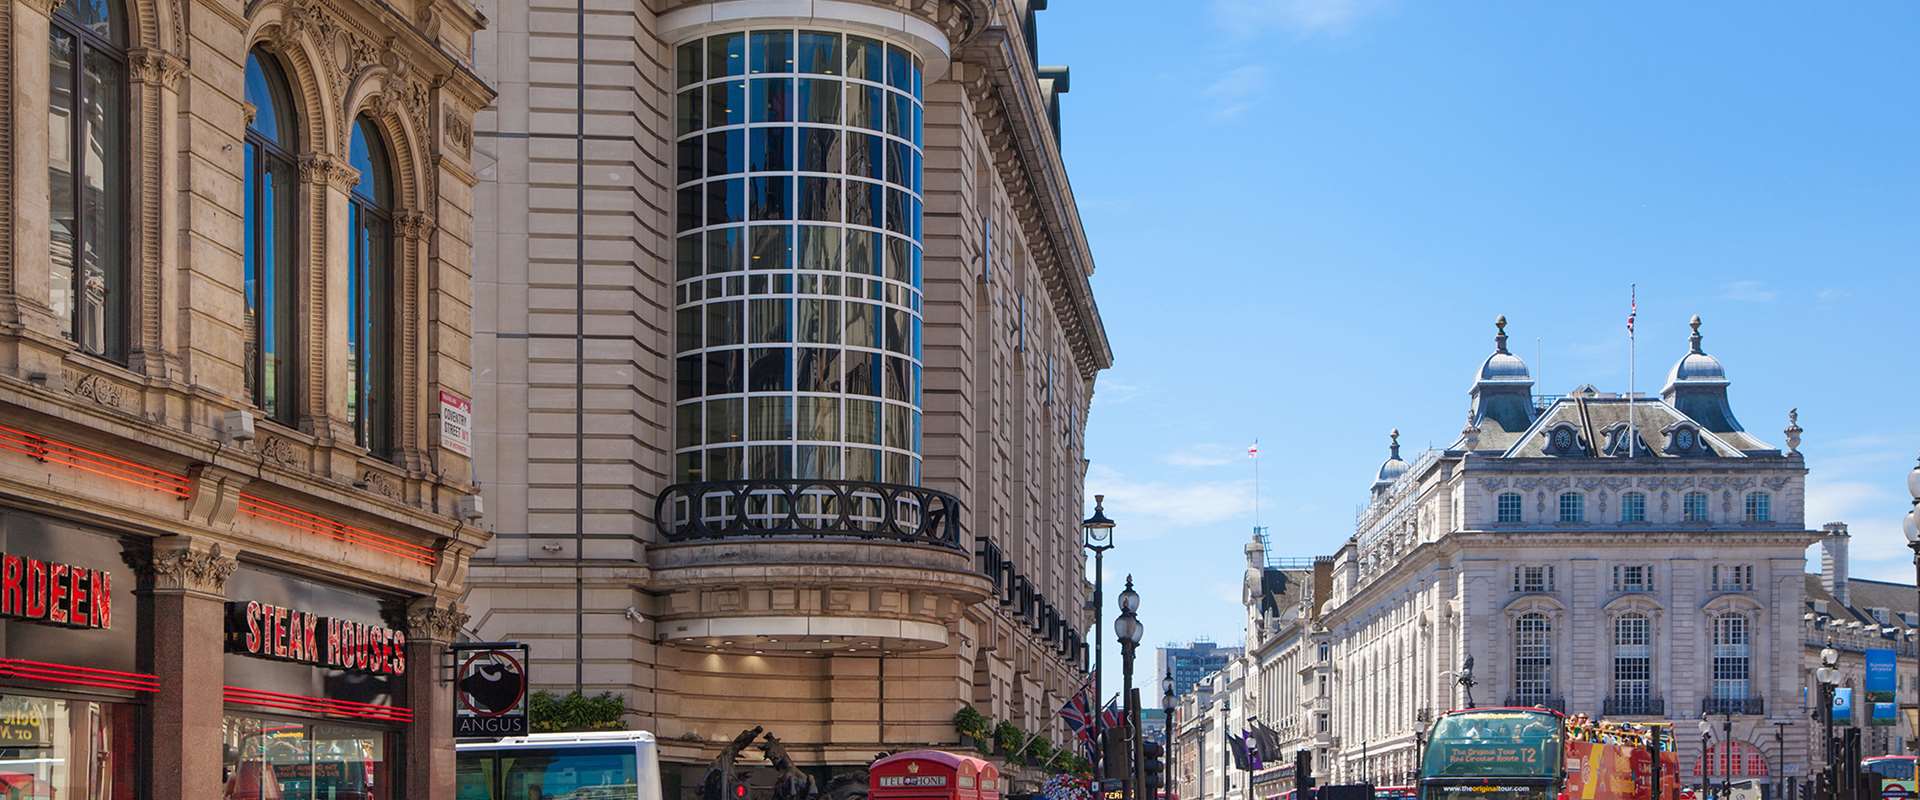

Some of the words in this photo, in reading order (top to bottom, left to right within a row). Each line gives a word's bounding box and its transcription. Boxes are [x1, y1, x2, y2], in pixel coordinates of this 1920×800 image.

[445, 408, 467, 425] COVENTRY
[445, 421, 461, 437] STREET
[2, 554, 112, 629] RDEEN
[246, 600, 318, 663] STEAK
[327, 615, 405, 675] HOUSES
[460, 718, 522, 732] ANGUS
[1520, 747, 1537, 763] T2
[1443, 785, 1530, 793] www.theoriginaltour.com
